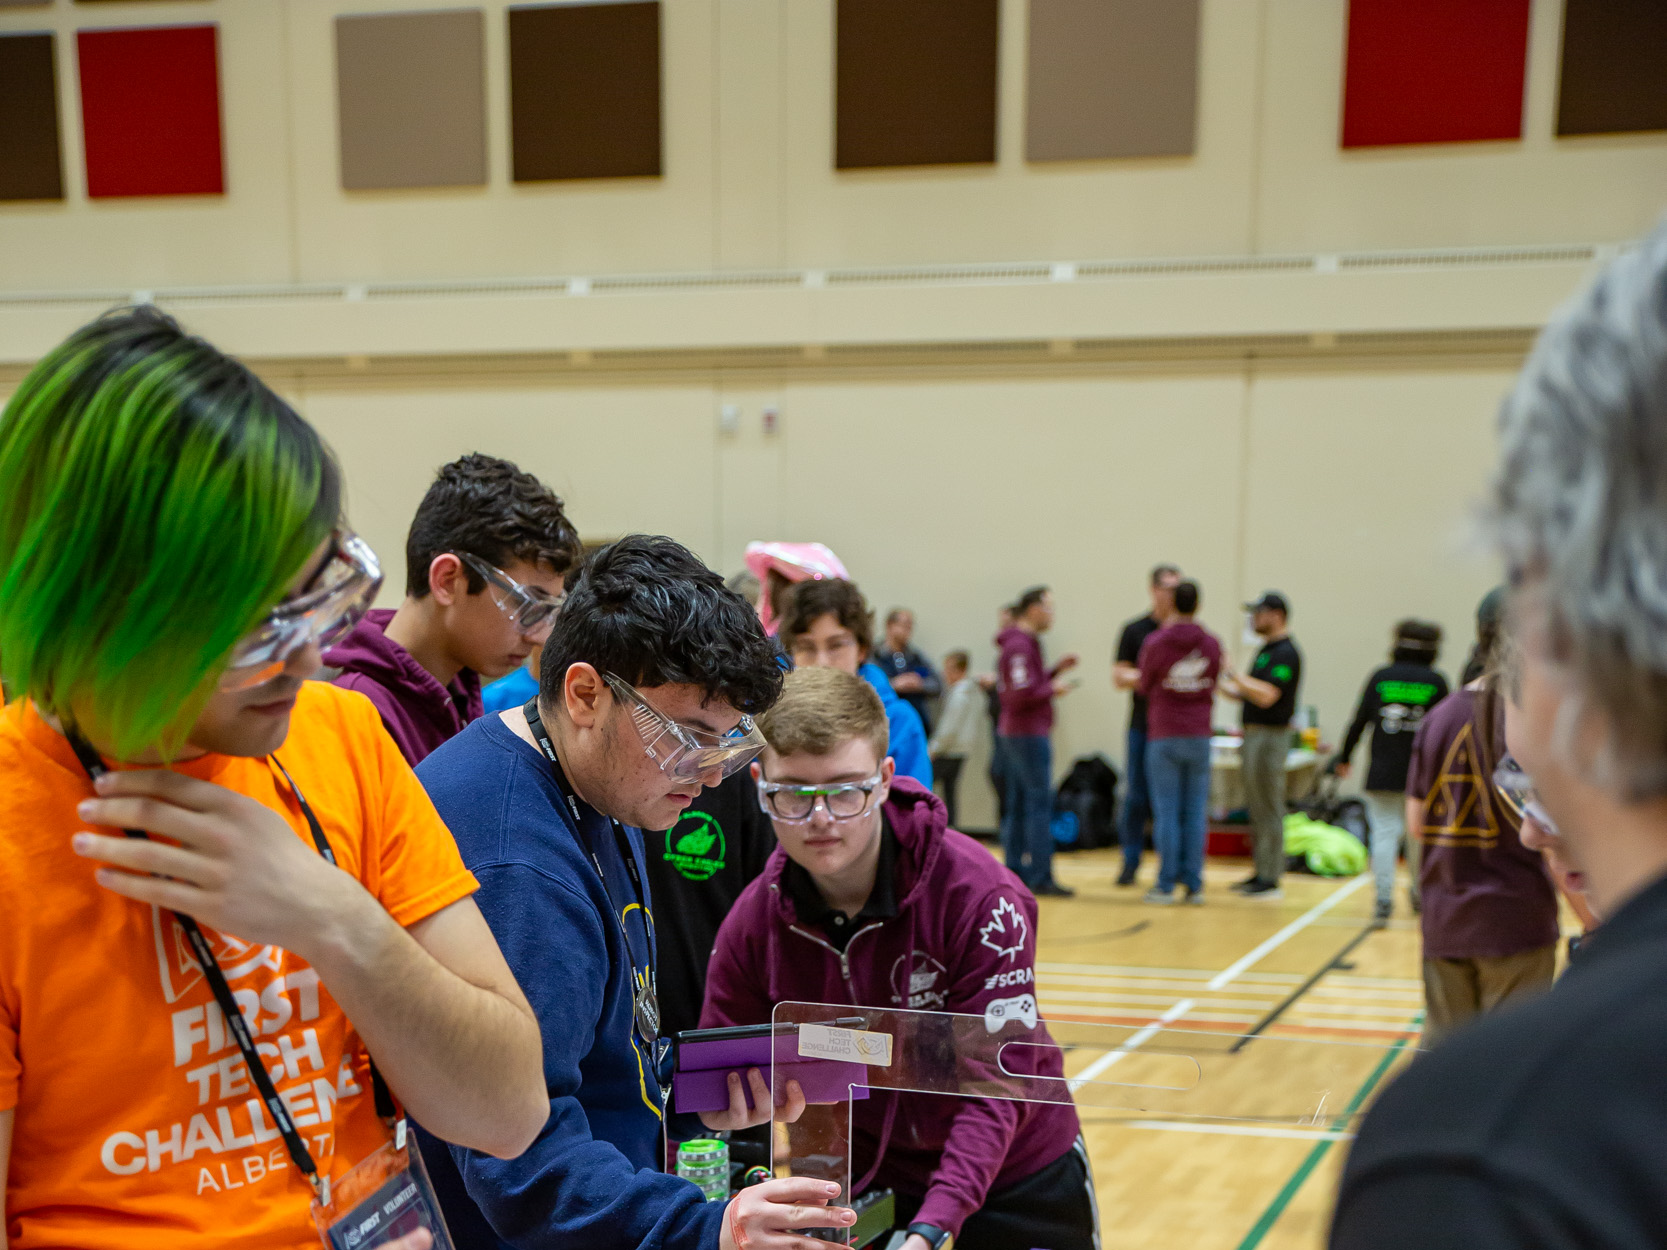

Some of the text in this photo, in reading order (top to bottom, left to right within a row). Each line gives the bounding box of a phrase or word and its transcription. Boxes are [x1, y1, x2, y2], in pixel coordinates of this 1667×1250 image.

[171, 967, 320, 1067] FIRST
[186, 1028, 325, 1106] TECH
[101, 1053, 363, 1176] CHALLENE
[196, 1132, 336, 1196] ALBET
